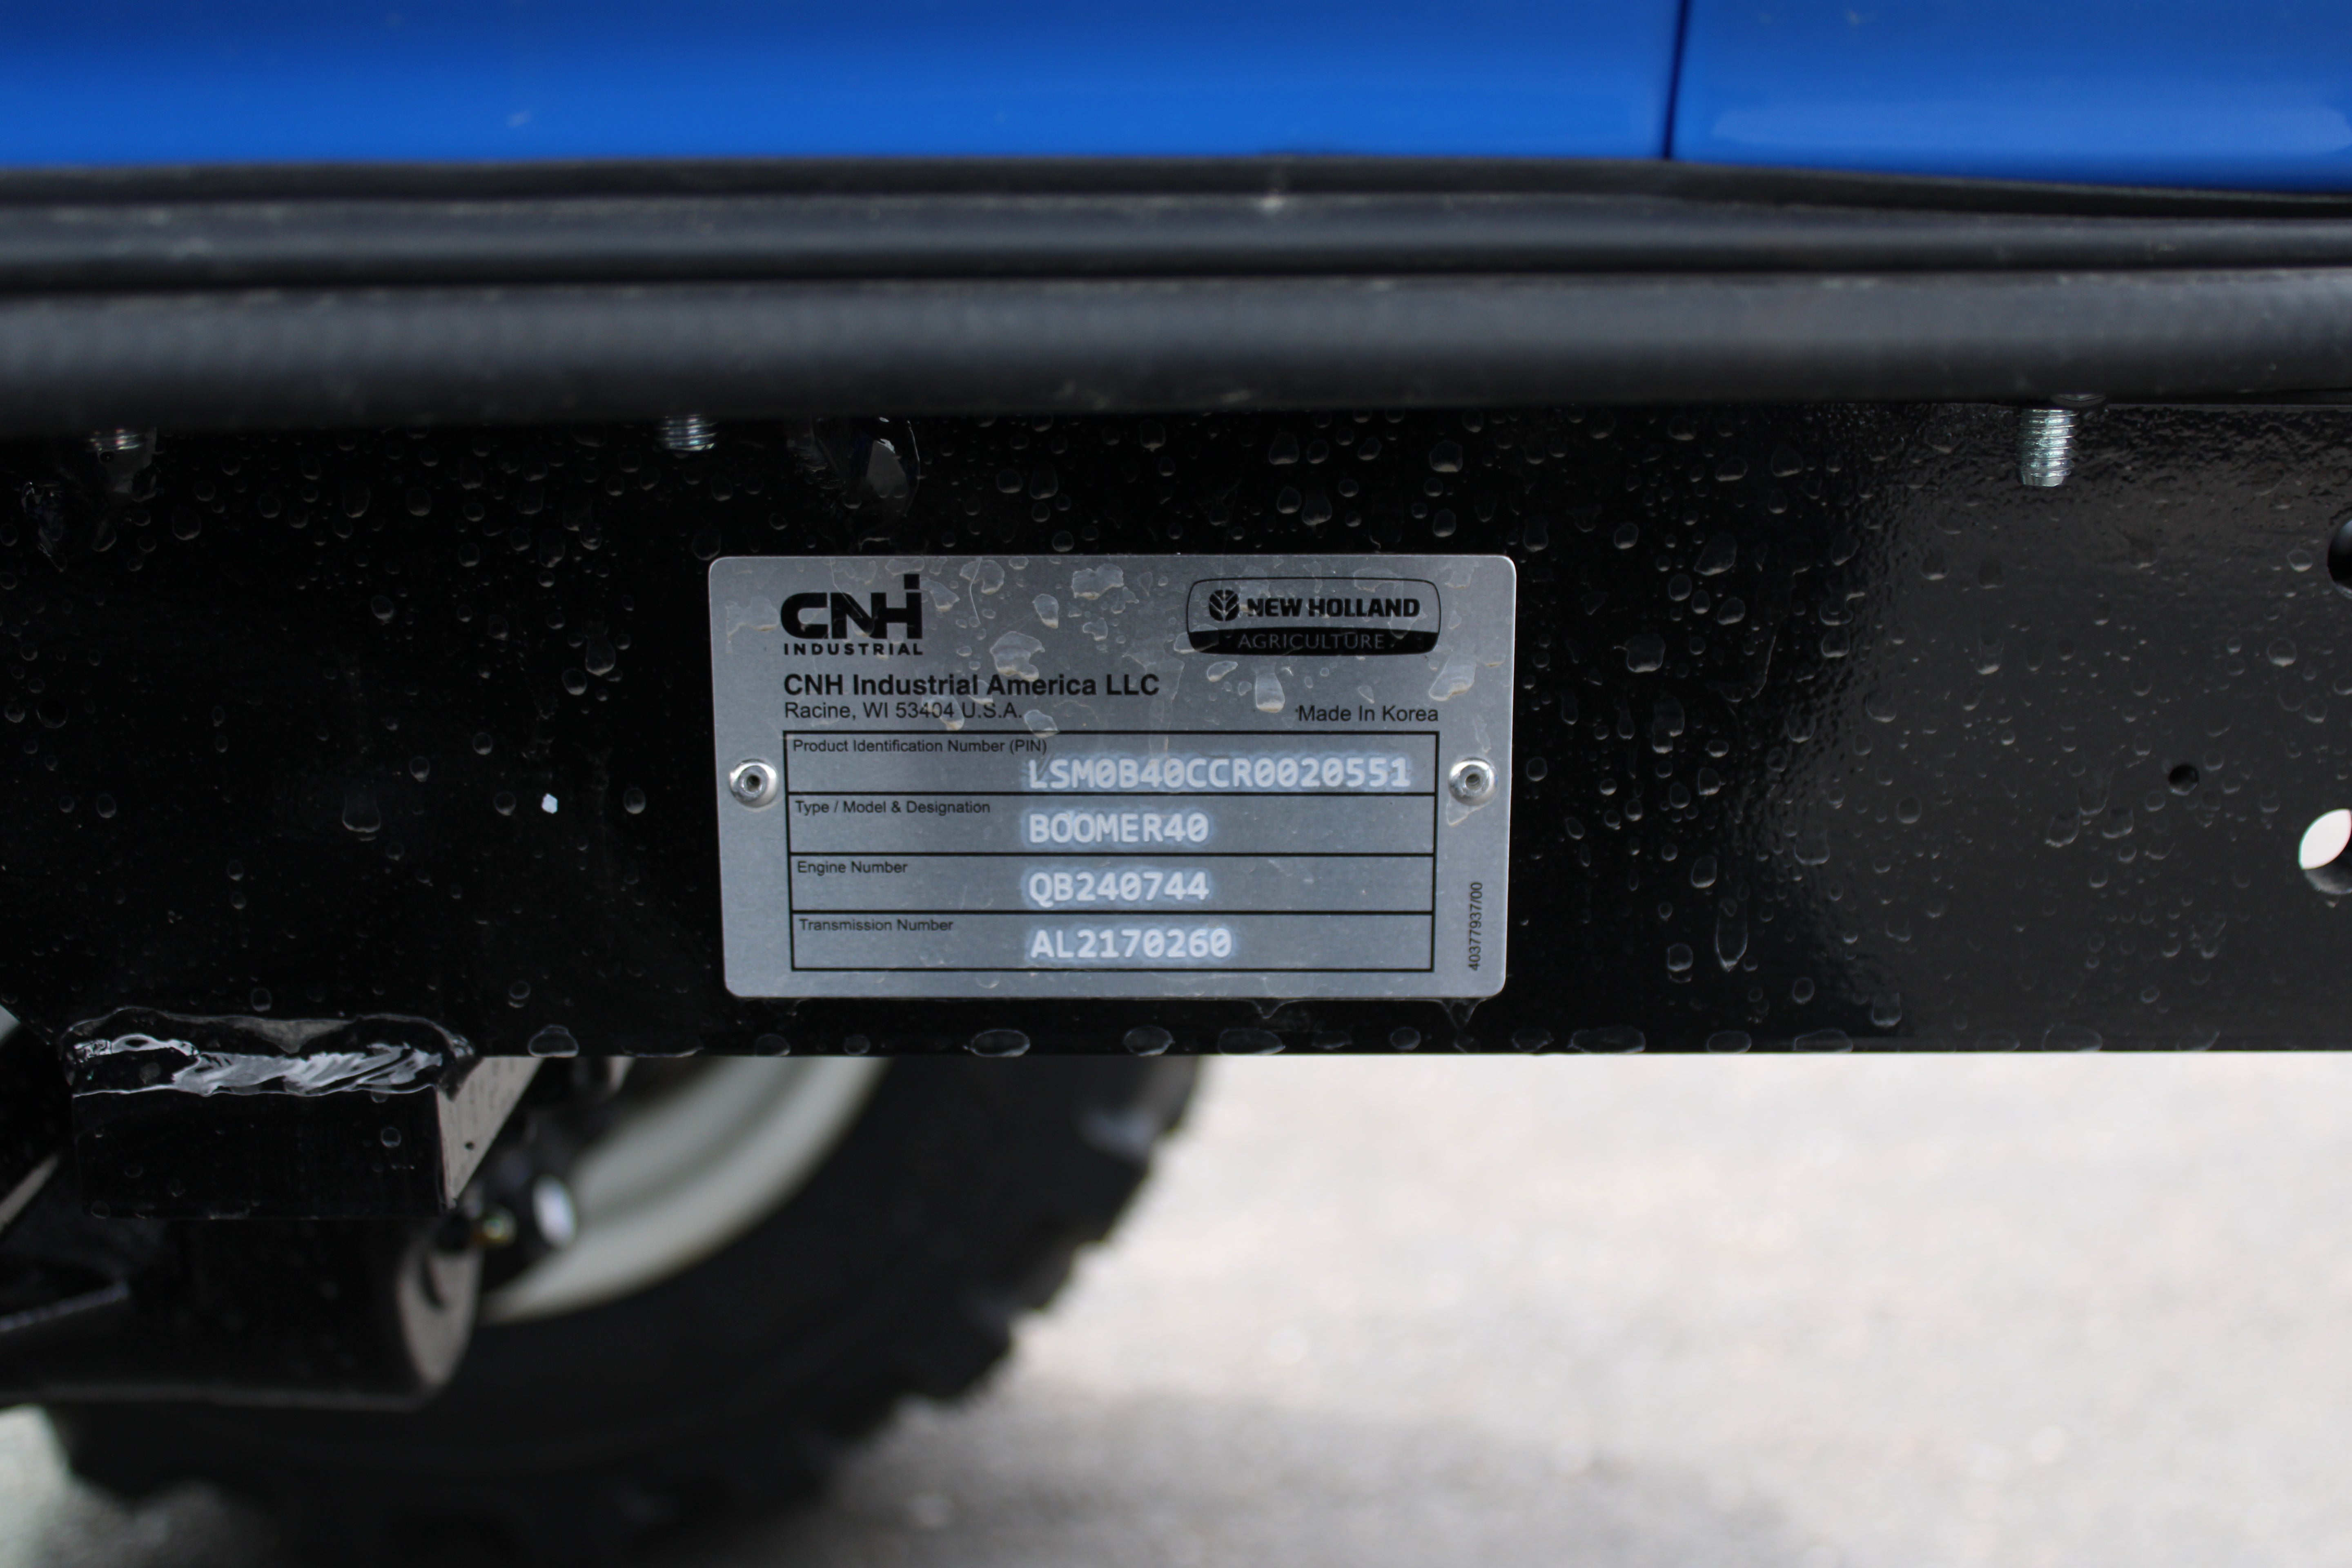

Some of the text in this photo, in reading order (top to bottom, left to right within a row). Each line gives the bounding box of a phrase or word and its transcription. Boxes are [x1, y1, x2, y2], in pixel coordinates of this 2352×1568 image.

[1247, 598, 1420, 617] NEW HOLLAND
[784, 644, 923, 655] INDUSTRIAL
[1238, 633, 1385, 650] AGRICULTURE
[784, 674, 1159, 696] CNH Industrial America LLC
[785, 702, 1022, 722] Racine, WI 53404 U.S.A.
[1298, 706, 1438, 722] Made In Korea
[793, 739, 1047, 755] Product Identification Number (PIN)
[1029, 758, 1411, 788] LSM0B40CCR0020551
[795, 801, 990, 817] Type / Model & Designation
[1029, 813, 1209, 843] BOOMER40
[798, 862, 907, 876] Engine Number
[1029, 872, 1209, 907] QB240744
[800, 919, 953, 931] Transmission Number
[1468, 882, 1483, 971] 40377937/00
[1030, 929, 1232, 958] AL2170260
